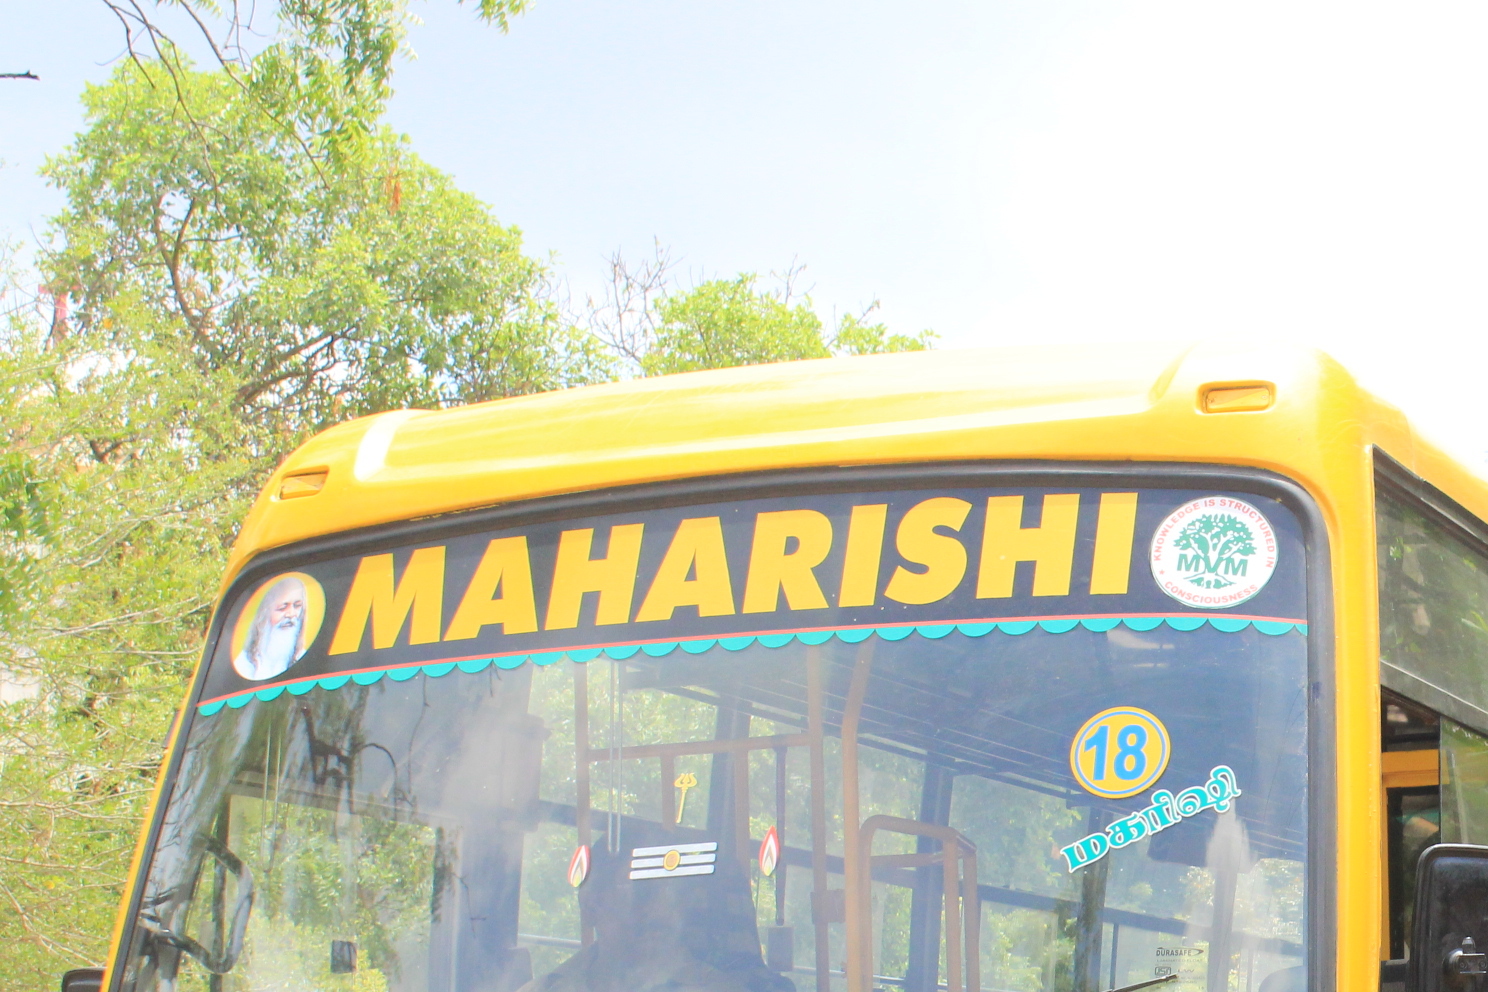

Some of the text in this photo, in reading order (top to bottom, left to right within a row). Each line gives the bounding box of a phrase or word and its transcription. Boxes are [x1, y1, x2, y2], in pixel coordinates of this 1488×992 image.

[1153, 499, 1275, 569] KNOWLEDGE IS STRUCTURED IN
[1176, 553, 1249, 577] MVM
[327, 491, 1140, 656] MAHARISHI
[1164, 581, 1258, 604] CONSCIOUSNESS
[1083, 724, 1148, 781] 18
[1060, 765, 1242, 873] மகரிஷி
